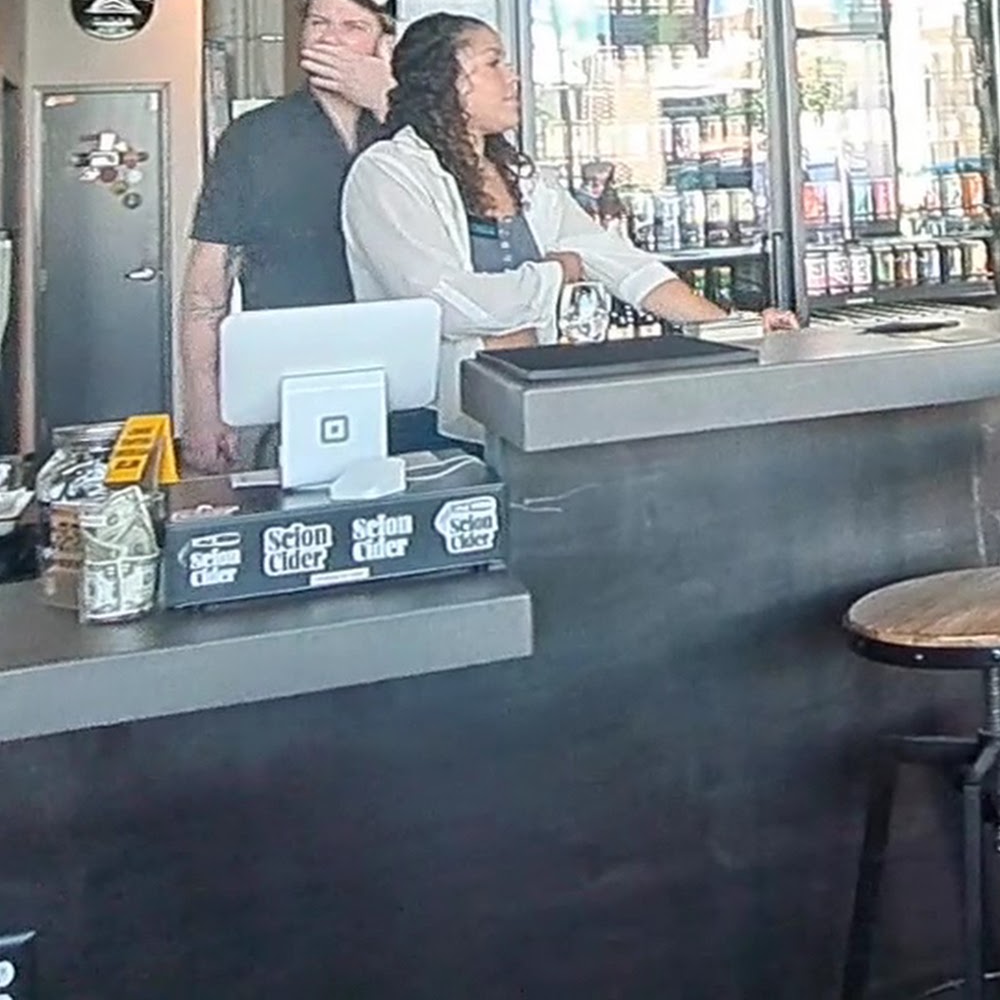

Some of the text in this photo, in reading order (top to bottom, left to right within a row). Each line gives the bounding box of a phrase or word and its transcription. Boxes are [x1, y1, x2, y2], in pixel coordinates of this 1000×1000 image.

[353, 513, 413, 542] Scion
[449, 512, 494, 533] Scion
[263, 523, 332, 550] Scion
[450, 531, 492, 550] Cider
[190, 547, 242, 569] Scion
[263, 547, 326, 575] Cider
[353, 536, 409, 562] Cider
[190, 567, 238, 587] Cider
